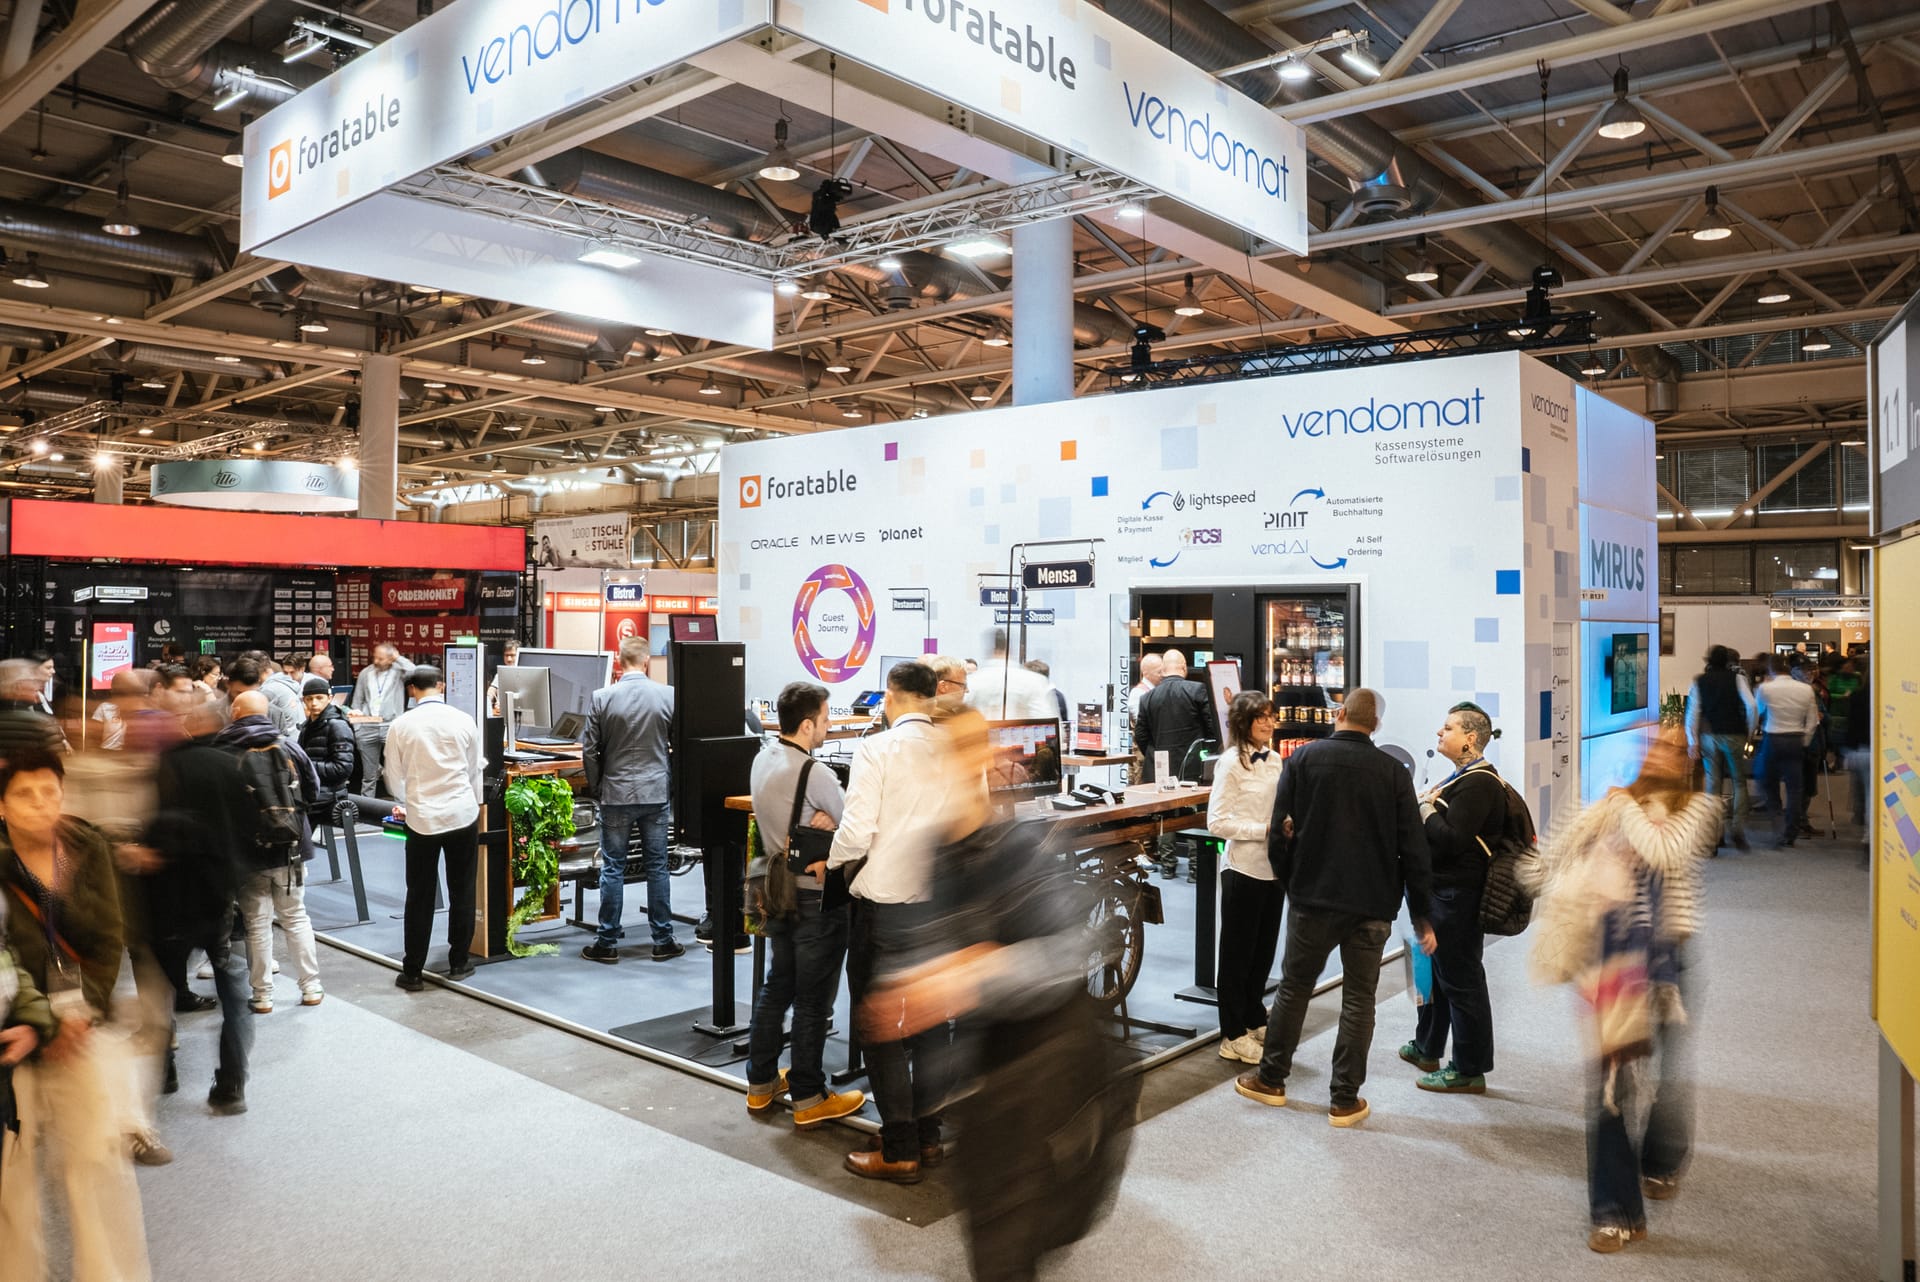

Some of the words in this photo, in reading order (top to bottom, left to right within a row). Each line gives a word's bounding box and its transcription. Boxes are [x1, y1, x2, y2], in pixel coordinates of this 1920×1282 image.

[905, 0, 1077, 90] oratable
[298, 94, 400, 175] foratable
[1123, 81, 1289, 202] vendomat
[1282, 387, 1485, 439] vendomat
[1375, 437, 1464, 452] Kassensysteme
[1375, 449, 1481, 464] Softwarelösungen
[768, 469, 857, 500] foratable
[1189, 490, 1256, 510] lightspeed
[1326, 496, 1383, 505] Automatisierte
[1332, 508, 1383, 516] Buchhaltung
[1117, 515, 1141, 524] Digitale
[1124, 526, 1152, 534] Payment
[592, 537, 624, 551] STÜHLE
[751, 537, 799, 550] ORACLE
[811, 532, 866, 546] MEWS
[1367, 535, 1382, 543] Self
[1347, 548, 1382, 557] Ordering
[1591, 538, 1645, 592] MIRUS
[1037, 567, 1077, 585] Mensa
[397, 588, 458, 601] ORDERMONKEY
[613, 587, 636, 599] Bistrot
[990, 591, 1008, 603] Hotel
[655, 600, 689, 609] SINGER
[894, 599, 923, 609] Restaurant
[822, 613, 845, 622] Guest
[818, 624, 849, 634] Journey
[1803, 632, 1810, 640] 1
[1855, 632, 1863, 640] 2
[1120, 655, 1129, 713] MAGIC!
[1120, 718, 1129, 753] THE
